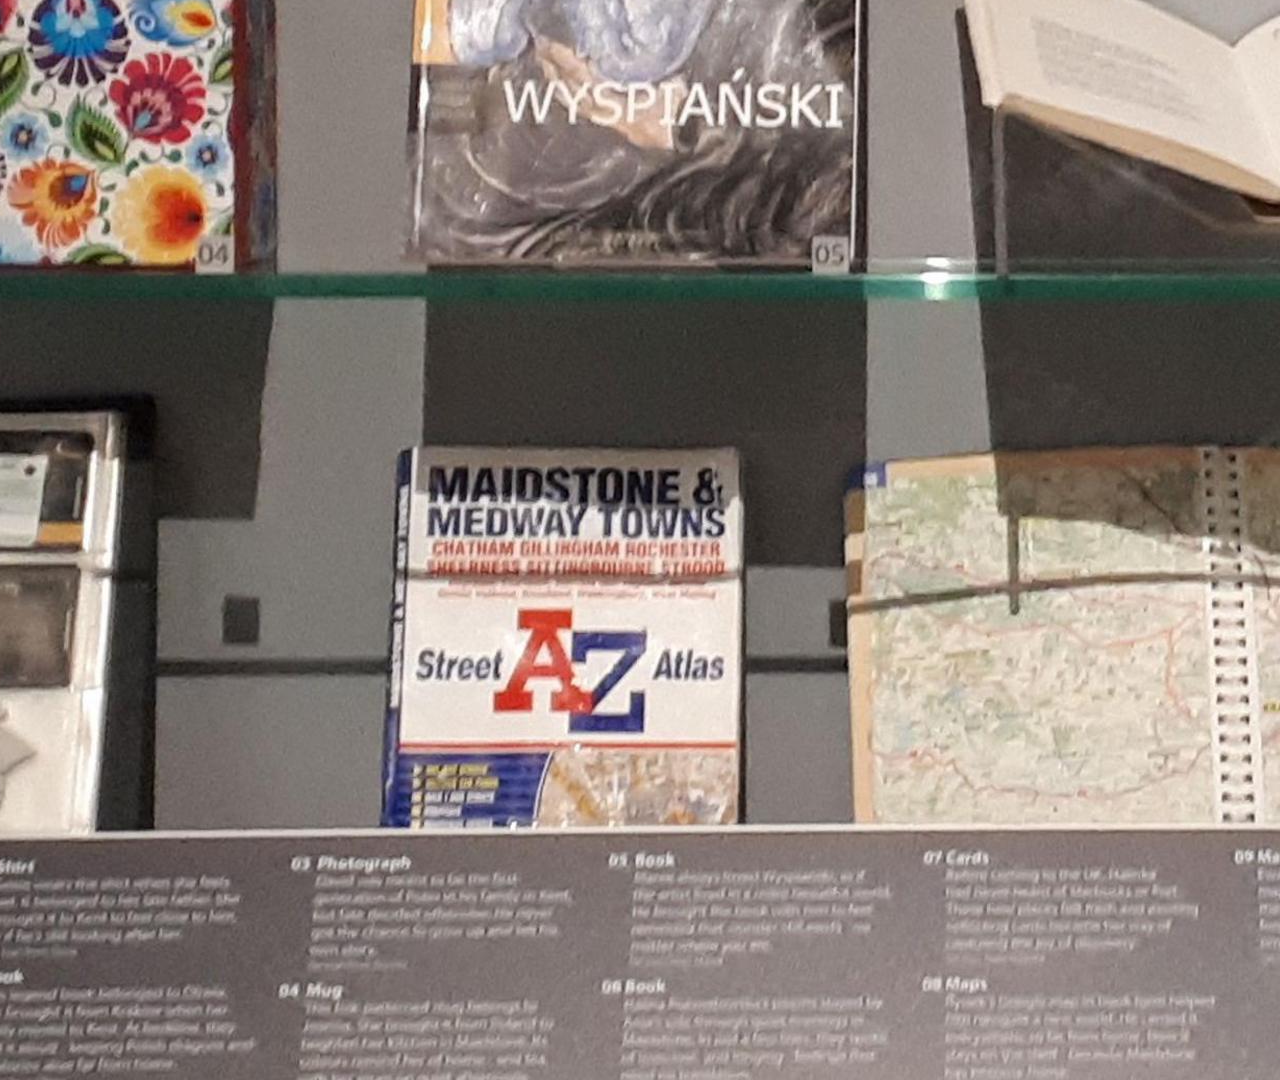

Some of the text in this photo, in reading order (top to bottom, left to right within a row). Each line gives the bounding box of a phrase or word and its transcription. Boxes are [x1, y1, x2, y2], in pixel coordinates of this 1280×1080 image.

[504, 69, 844, 129] WYSPIAŃSKI
[199, 243, 229, 265] 04
[816, 244, 844, 265] 05
[428, 466, 723, 505] MAIDSTONE &
[427, 506, 726, 538] MEDWAY TOWNS
[432, 540, 720, 558] CHATHAM GILLINGHAM ROCHESTER
[416, 648, 503, 680] Street
[653, 648, 725, 680] Atlas
[317, 855, 412, 873] Photograph
[635, 852, 675, 868] Book
[946, 849, 989, 865] Cards
[306, 983, 343, 1000] Mug
[625, 979, 665, 994] Book
[946, 977, 988, 993] Maps
